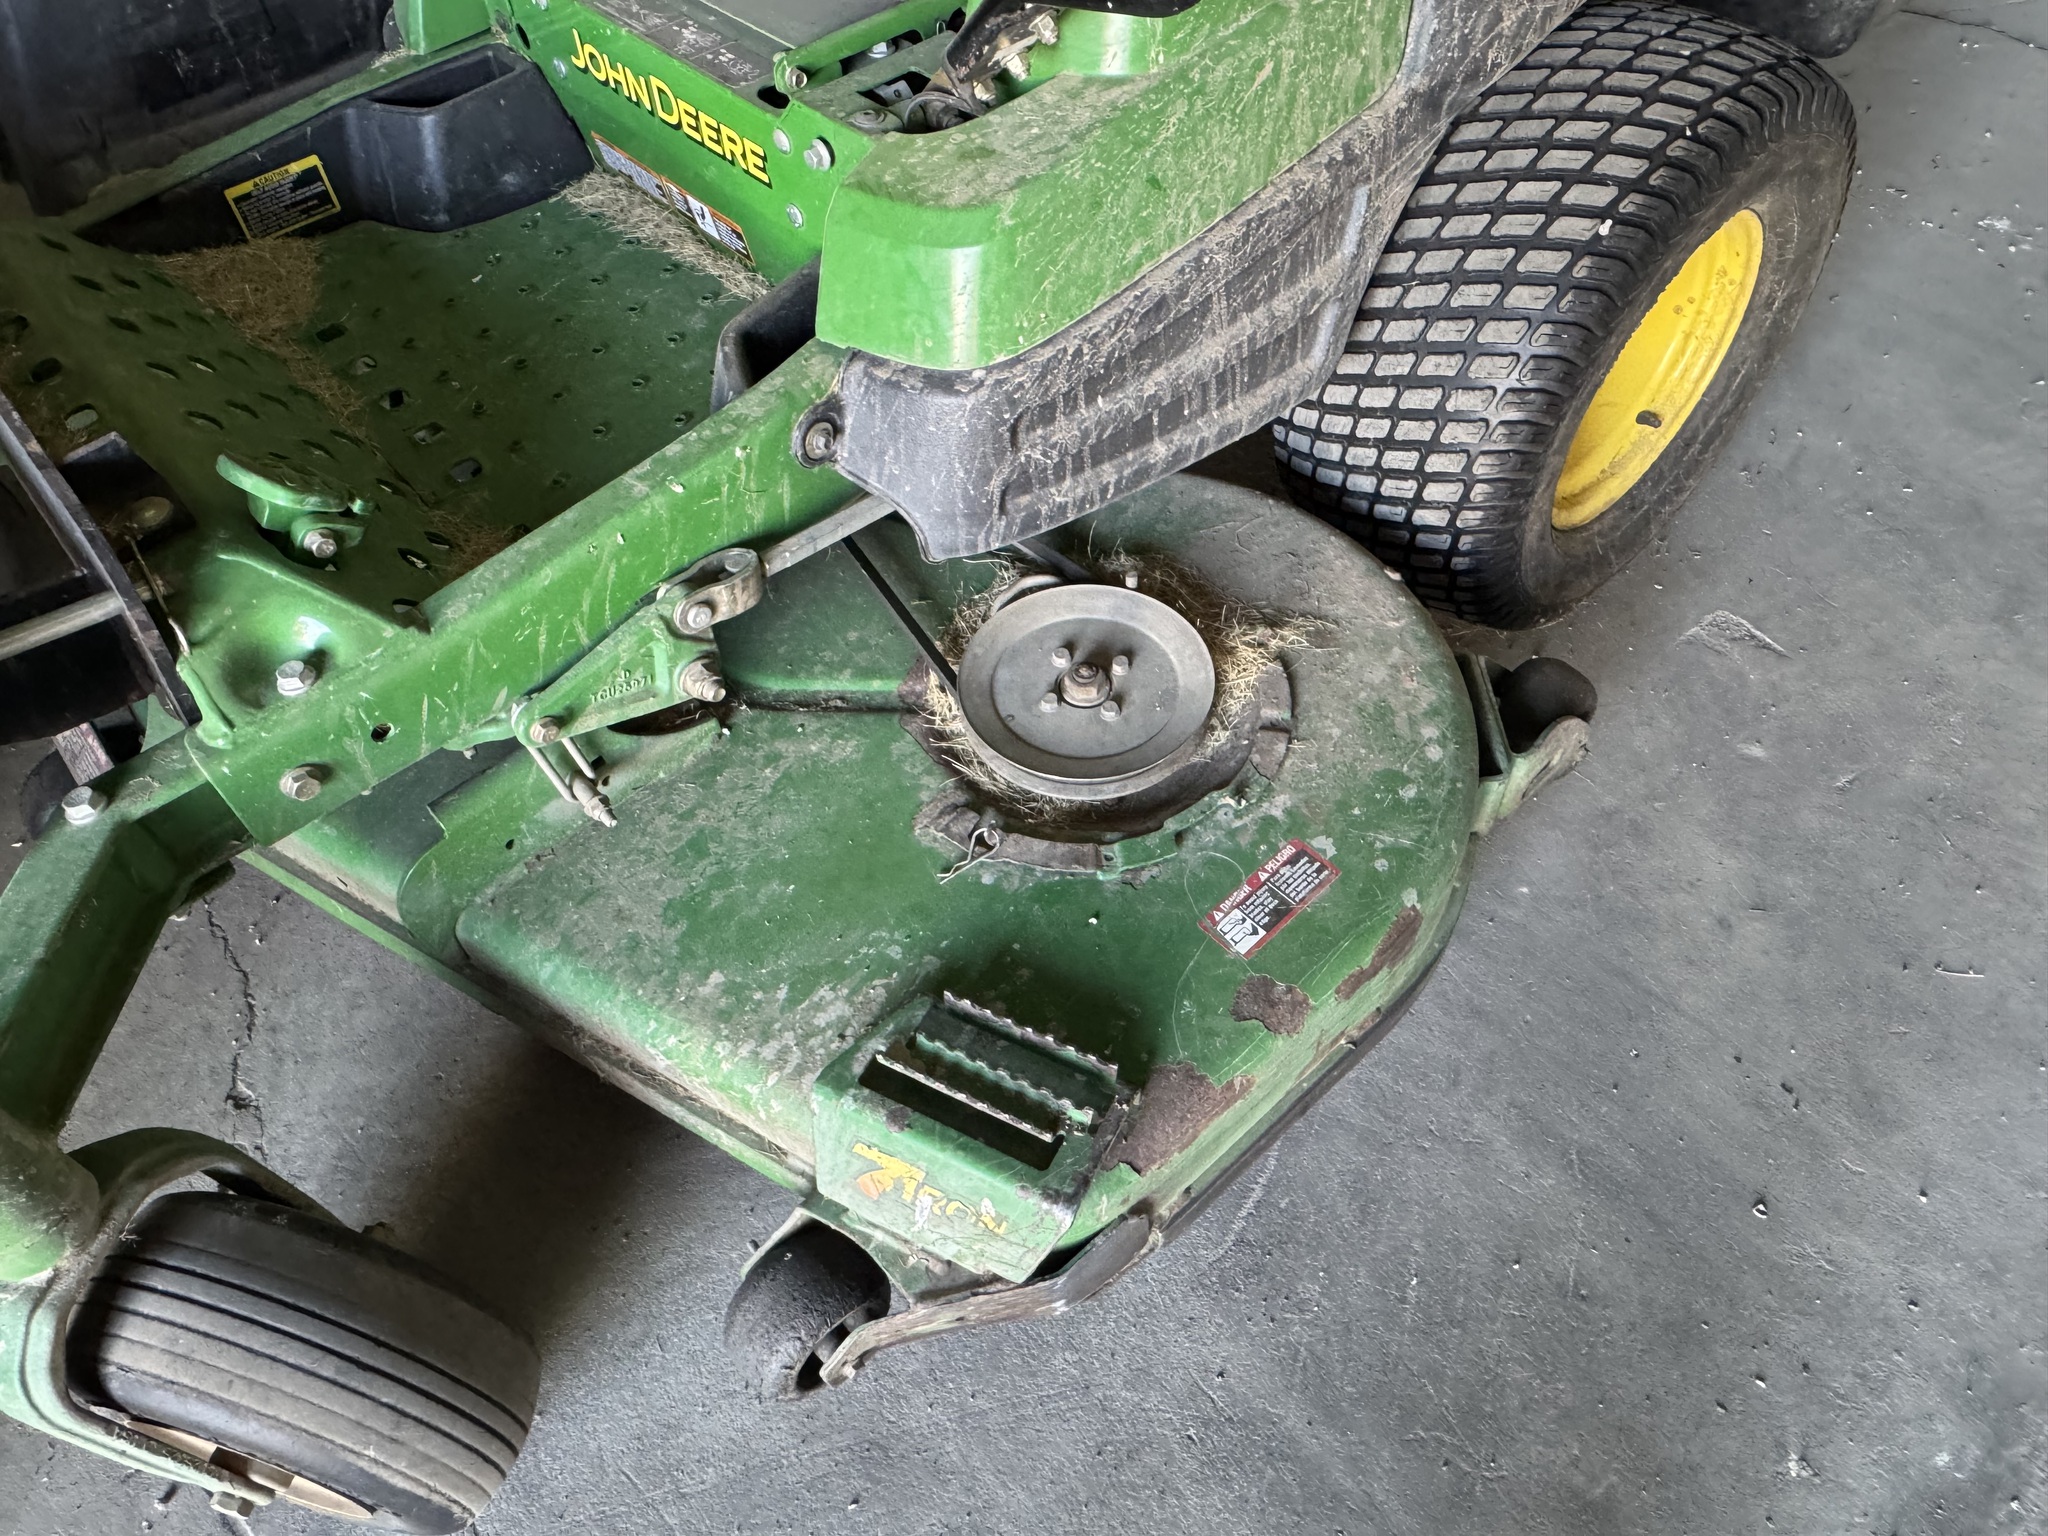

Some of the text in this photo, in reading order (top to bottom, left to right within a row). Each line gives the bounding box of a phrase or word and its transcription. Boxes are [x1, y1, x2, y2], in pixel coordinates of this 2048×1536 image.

[570, 28, 653, 114] JOHN
[649, 75, 771, 188] DEERE
[258, 168, 291, 185] CAUTION
[1264, 844, 1297, 872] PELIGRO
